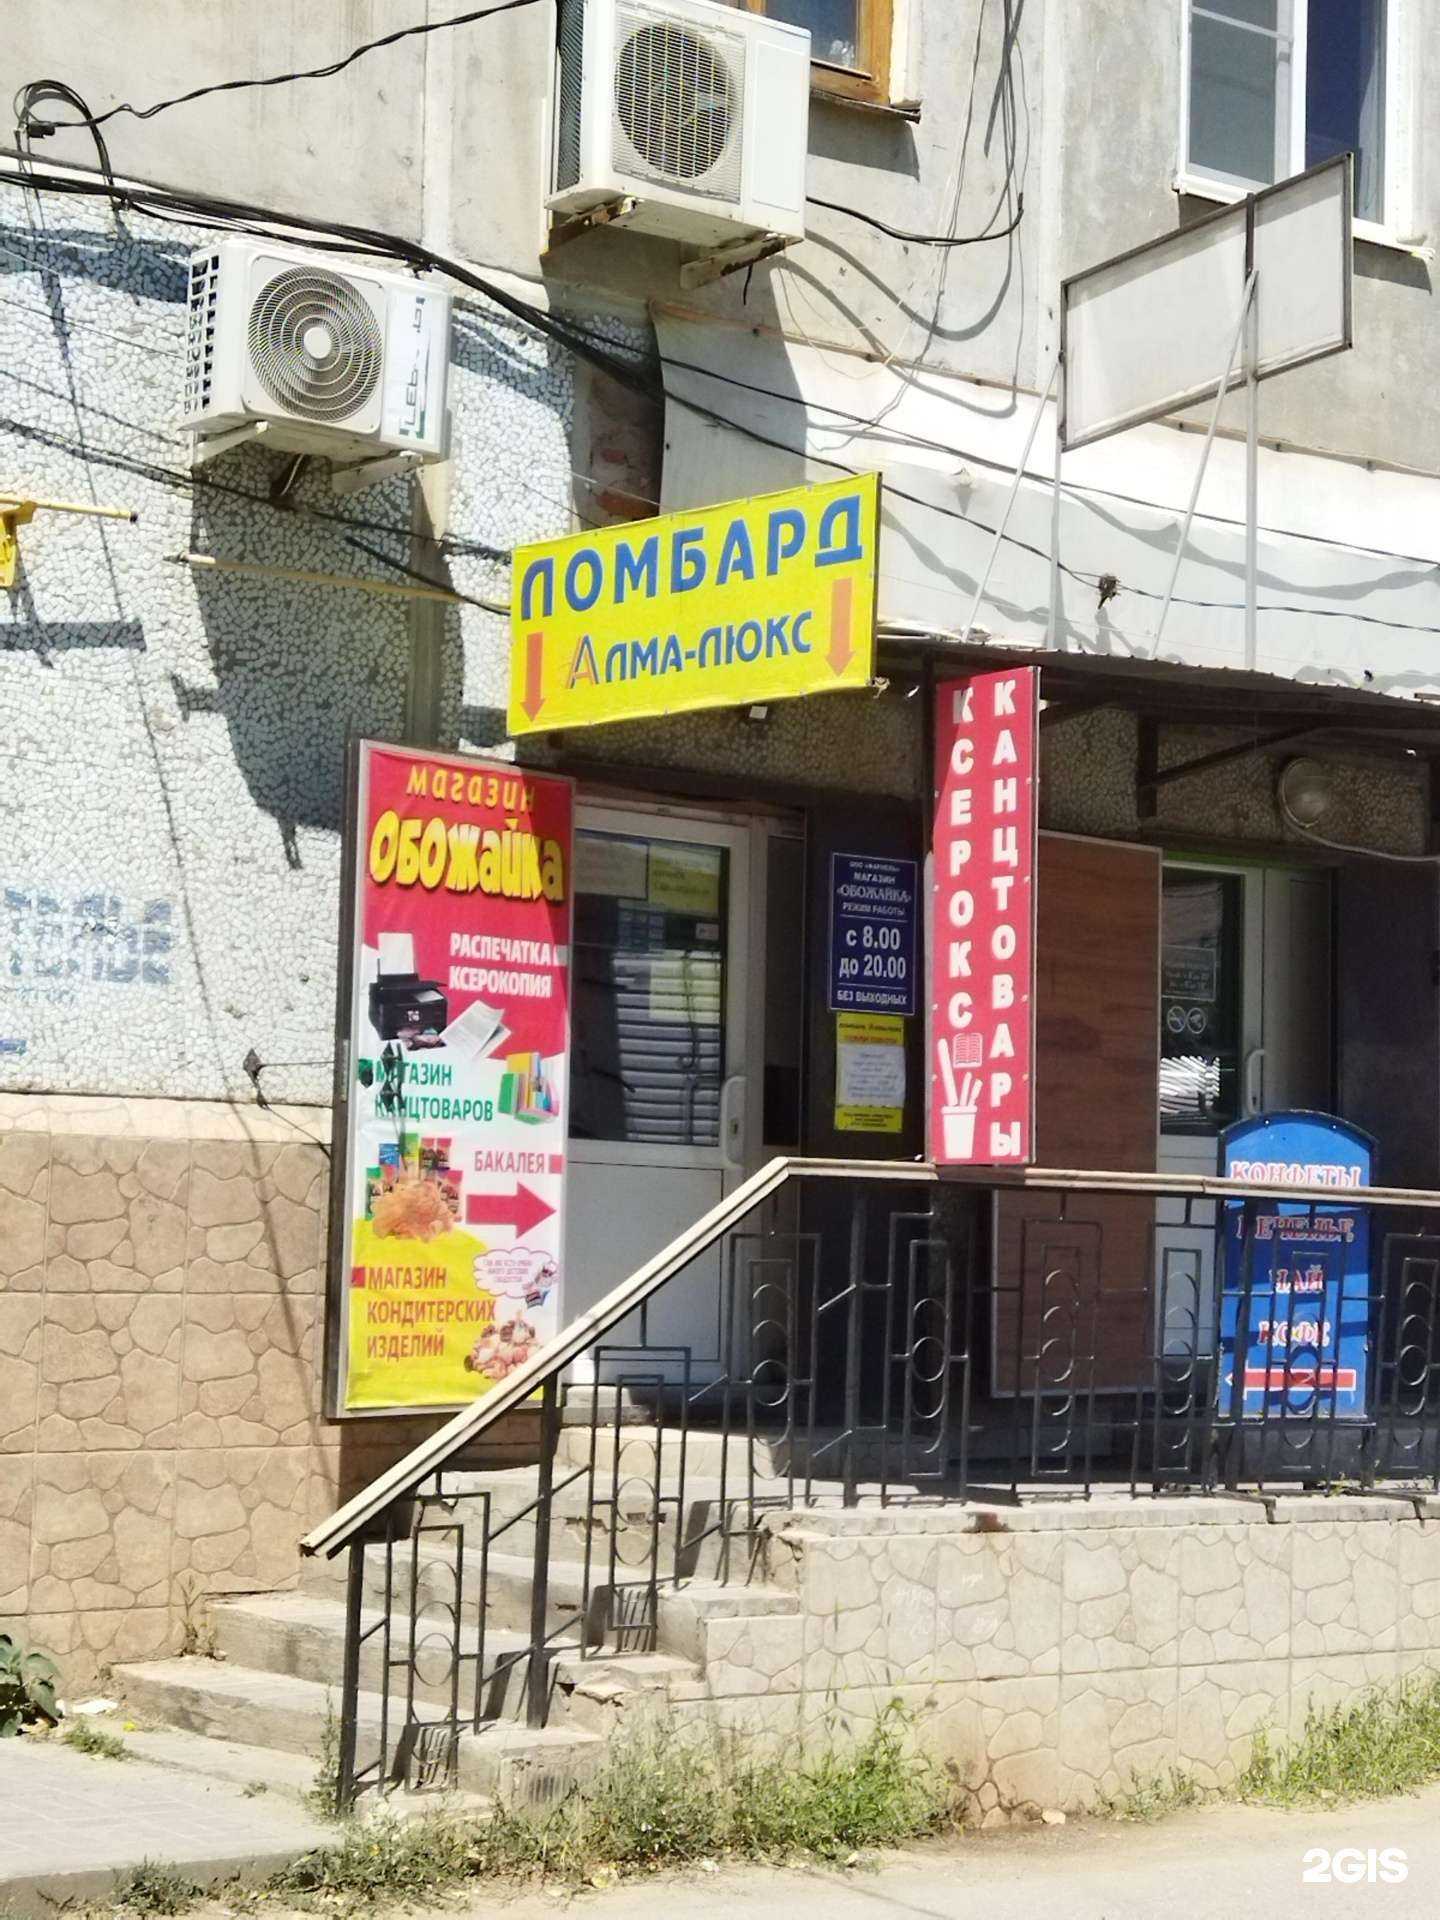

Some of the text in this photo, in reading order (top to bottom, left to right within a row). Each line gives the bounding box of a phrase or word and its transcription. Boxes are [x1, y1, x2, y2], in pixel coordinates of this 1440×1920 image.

[521, 494, 863, 622] ЛОМБАРД
[947, 686, 975, 1029] КСЕРОКС
[853, 871, 897, 885] МАГАЗИН
[842, 902, 905, 916] РЕЖИМ РАБОТЫ
[989, 679, 1022, 1157] КАНЦТОВАРЫ
[449, 932, 552, 966] РАСПЕЧАТКА
[863, 925, 901, 950] 8.00
[863, 953, 906, 979] 20.00
[448, 965, 552, 998] КСЕРОКОПИЯ
[837, 989, 908, 1006] БЕЗ ВЫХОДНЫХ
[474, 1150, 545, 1174] БАКАЛЕЯ
[367, 1266, 447, 1290] МАГАЗИН
[367, 1299, 496, 1329] КОНДИТЕРСКИХ
[367, 1327, 445, 1362] ИЗДЕЛИЙ
